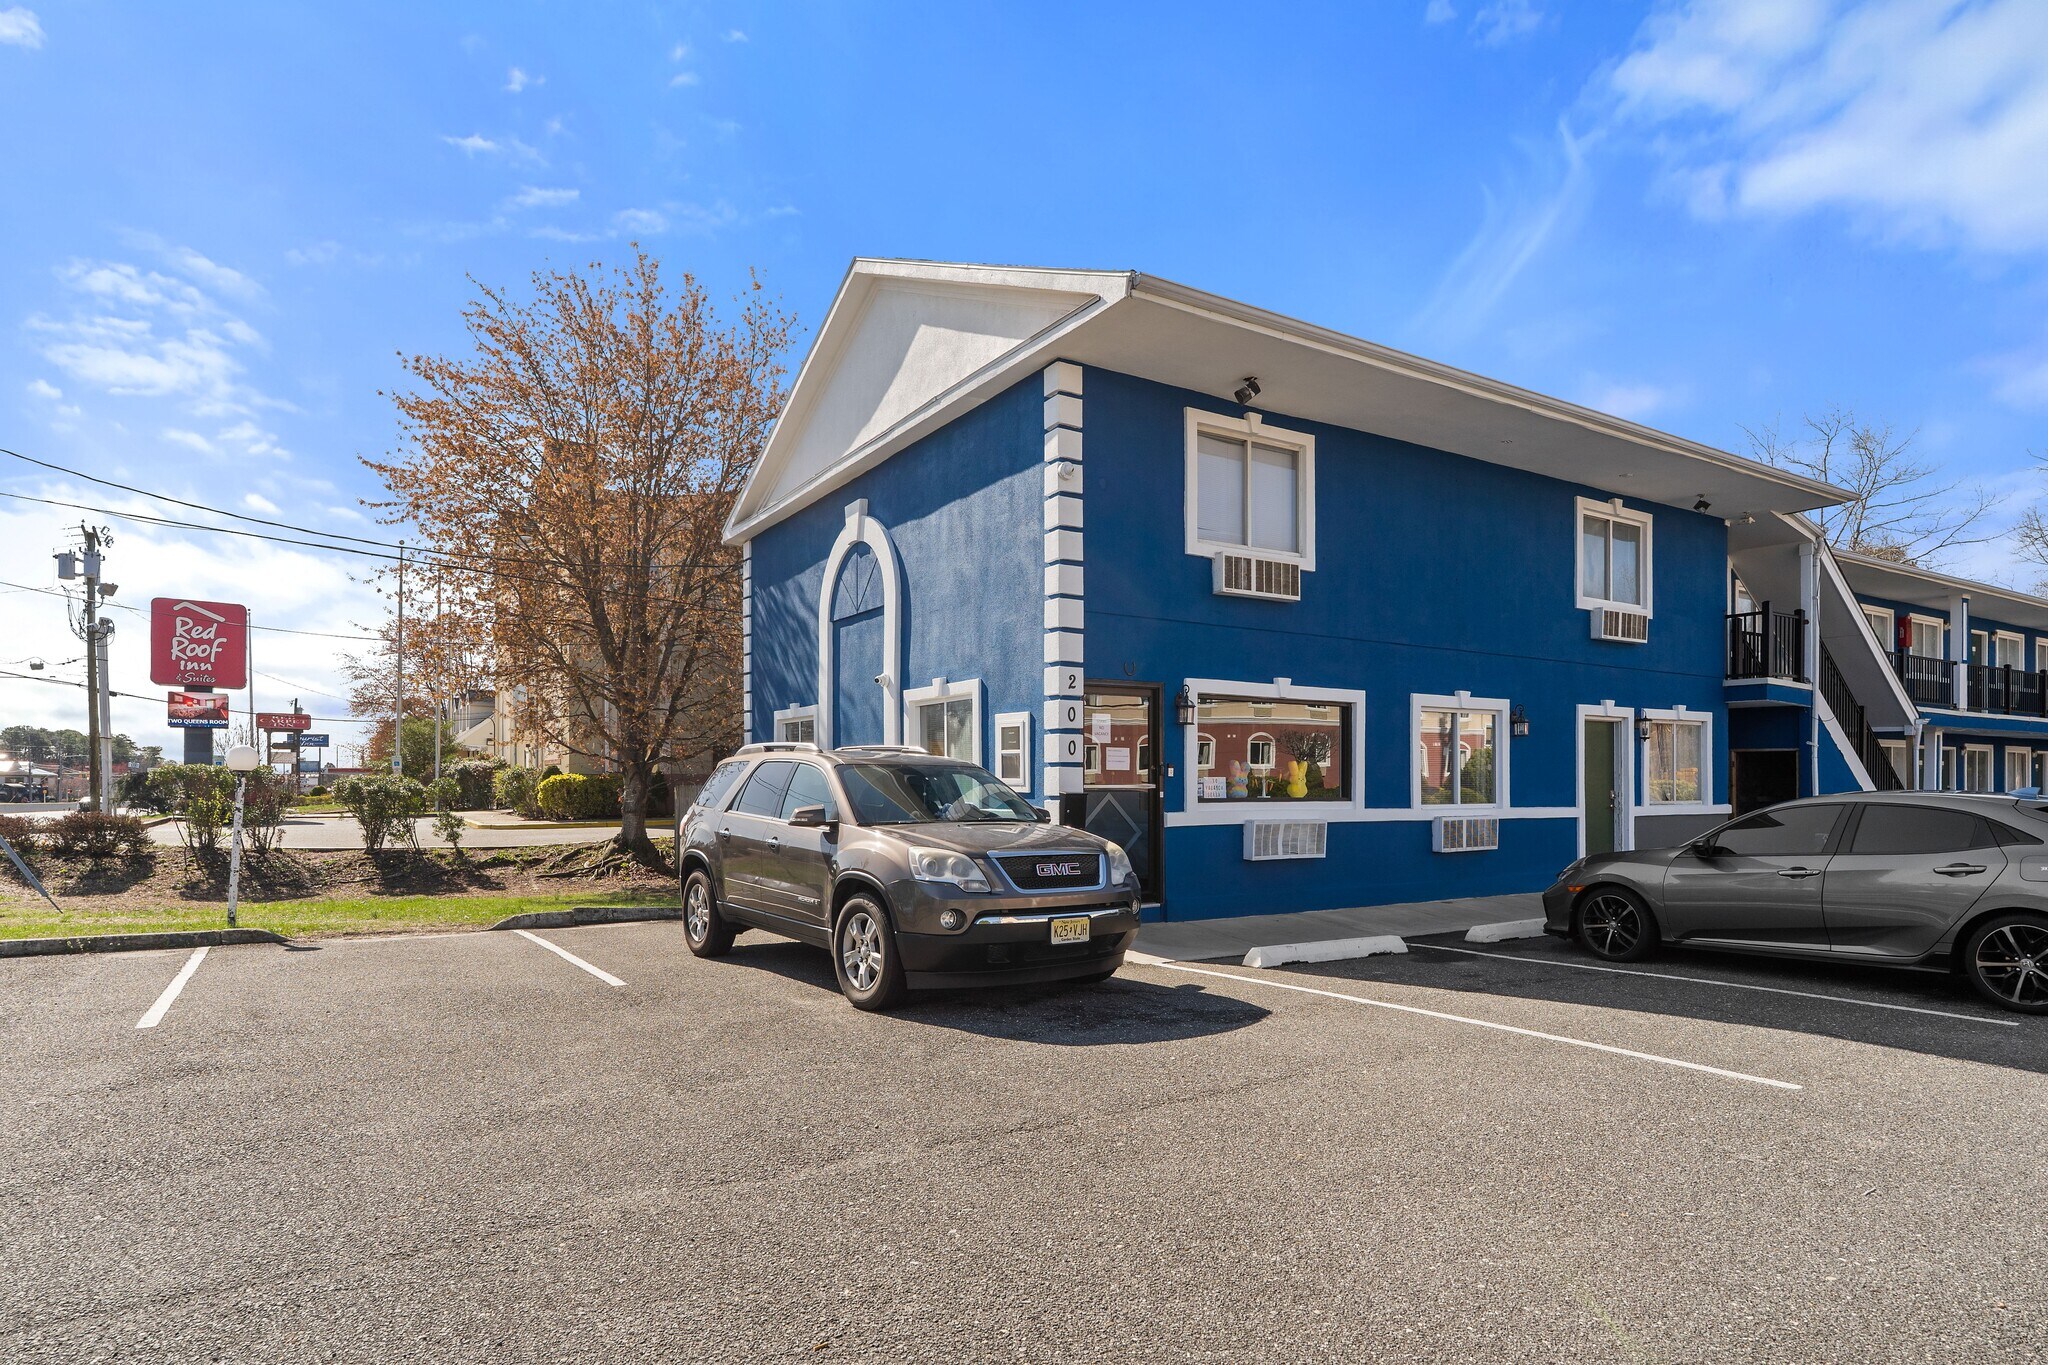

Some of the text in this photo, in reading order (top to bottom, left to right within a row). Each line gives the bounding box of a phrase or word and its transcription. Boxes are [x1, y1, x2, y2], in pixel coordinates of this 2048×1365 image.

[175, 616, 218, 639] Red
[171, 636, 228, 663] Roof
[182, 672, 217, 683] Suites
[1036, 862, 1081, 876] GMC
[1053, 923, 1088, 938] K25 VJH
